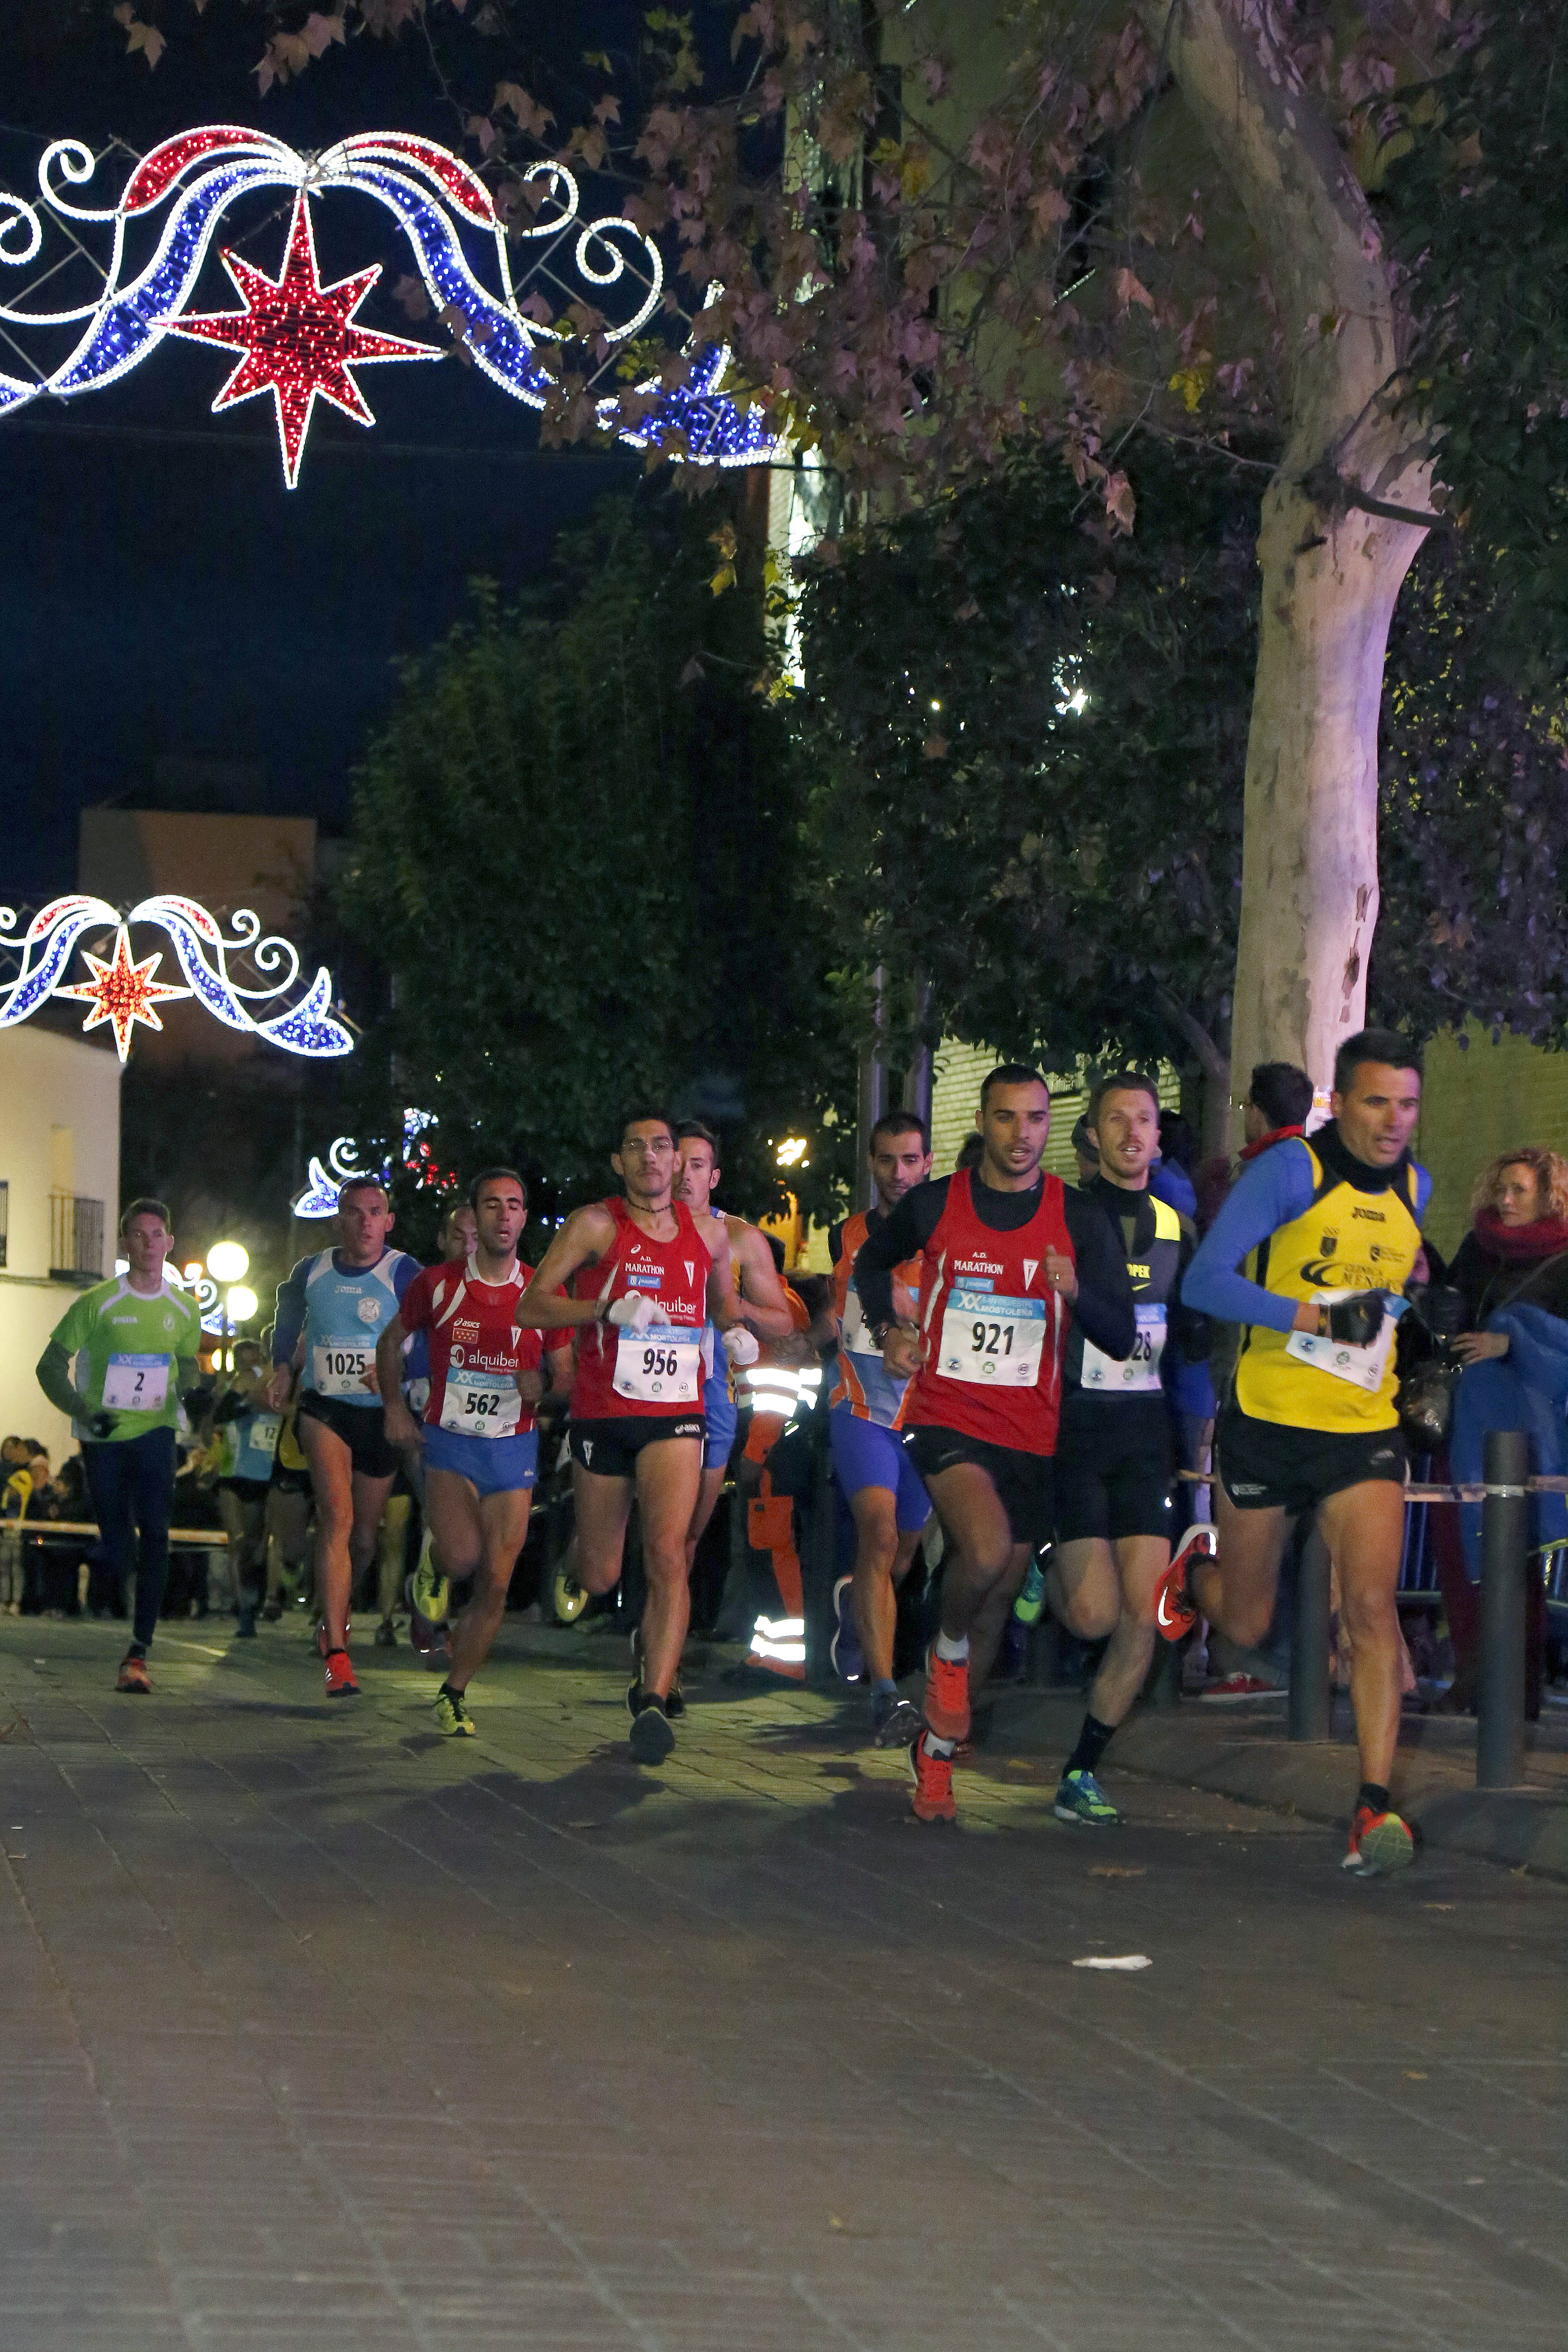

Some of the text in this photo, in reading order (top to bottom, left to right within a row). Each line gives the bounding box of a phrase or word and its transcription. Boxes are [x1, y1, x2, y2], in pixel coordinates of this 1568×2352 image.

[625, 1263, 664, 1275] MARATHON
[954, 1260, 1004, 1275] MARATHON
[971, 1321, 1014, 1355] 921
[326, 1353, 366, 1375] 1025
[469, 1350, 520, 1370] alquiber
[642, 1348, 678, 1376] 956
[135, 1372, 144, 1392] 2
[465, 1392, 500, 1416] 562
